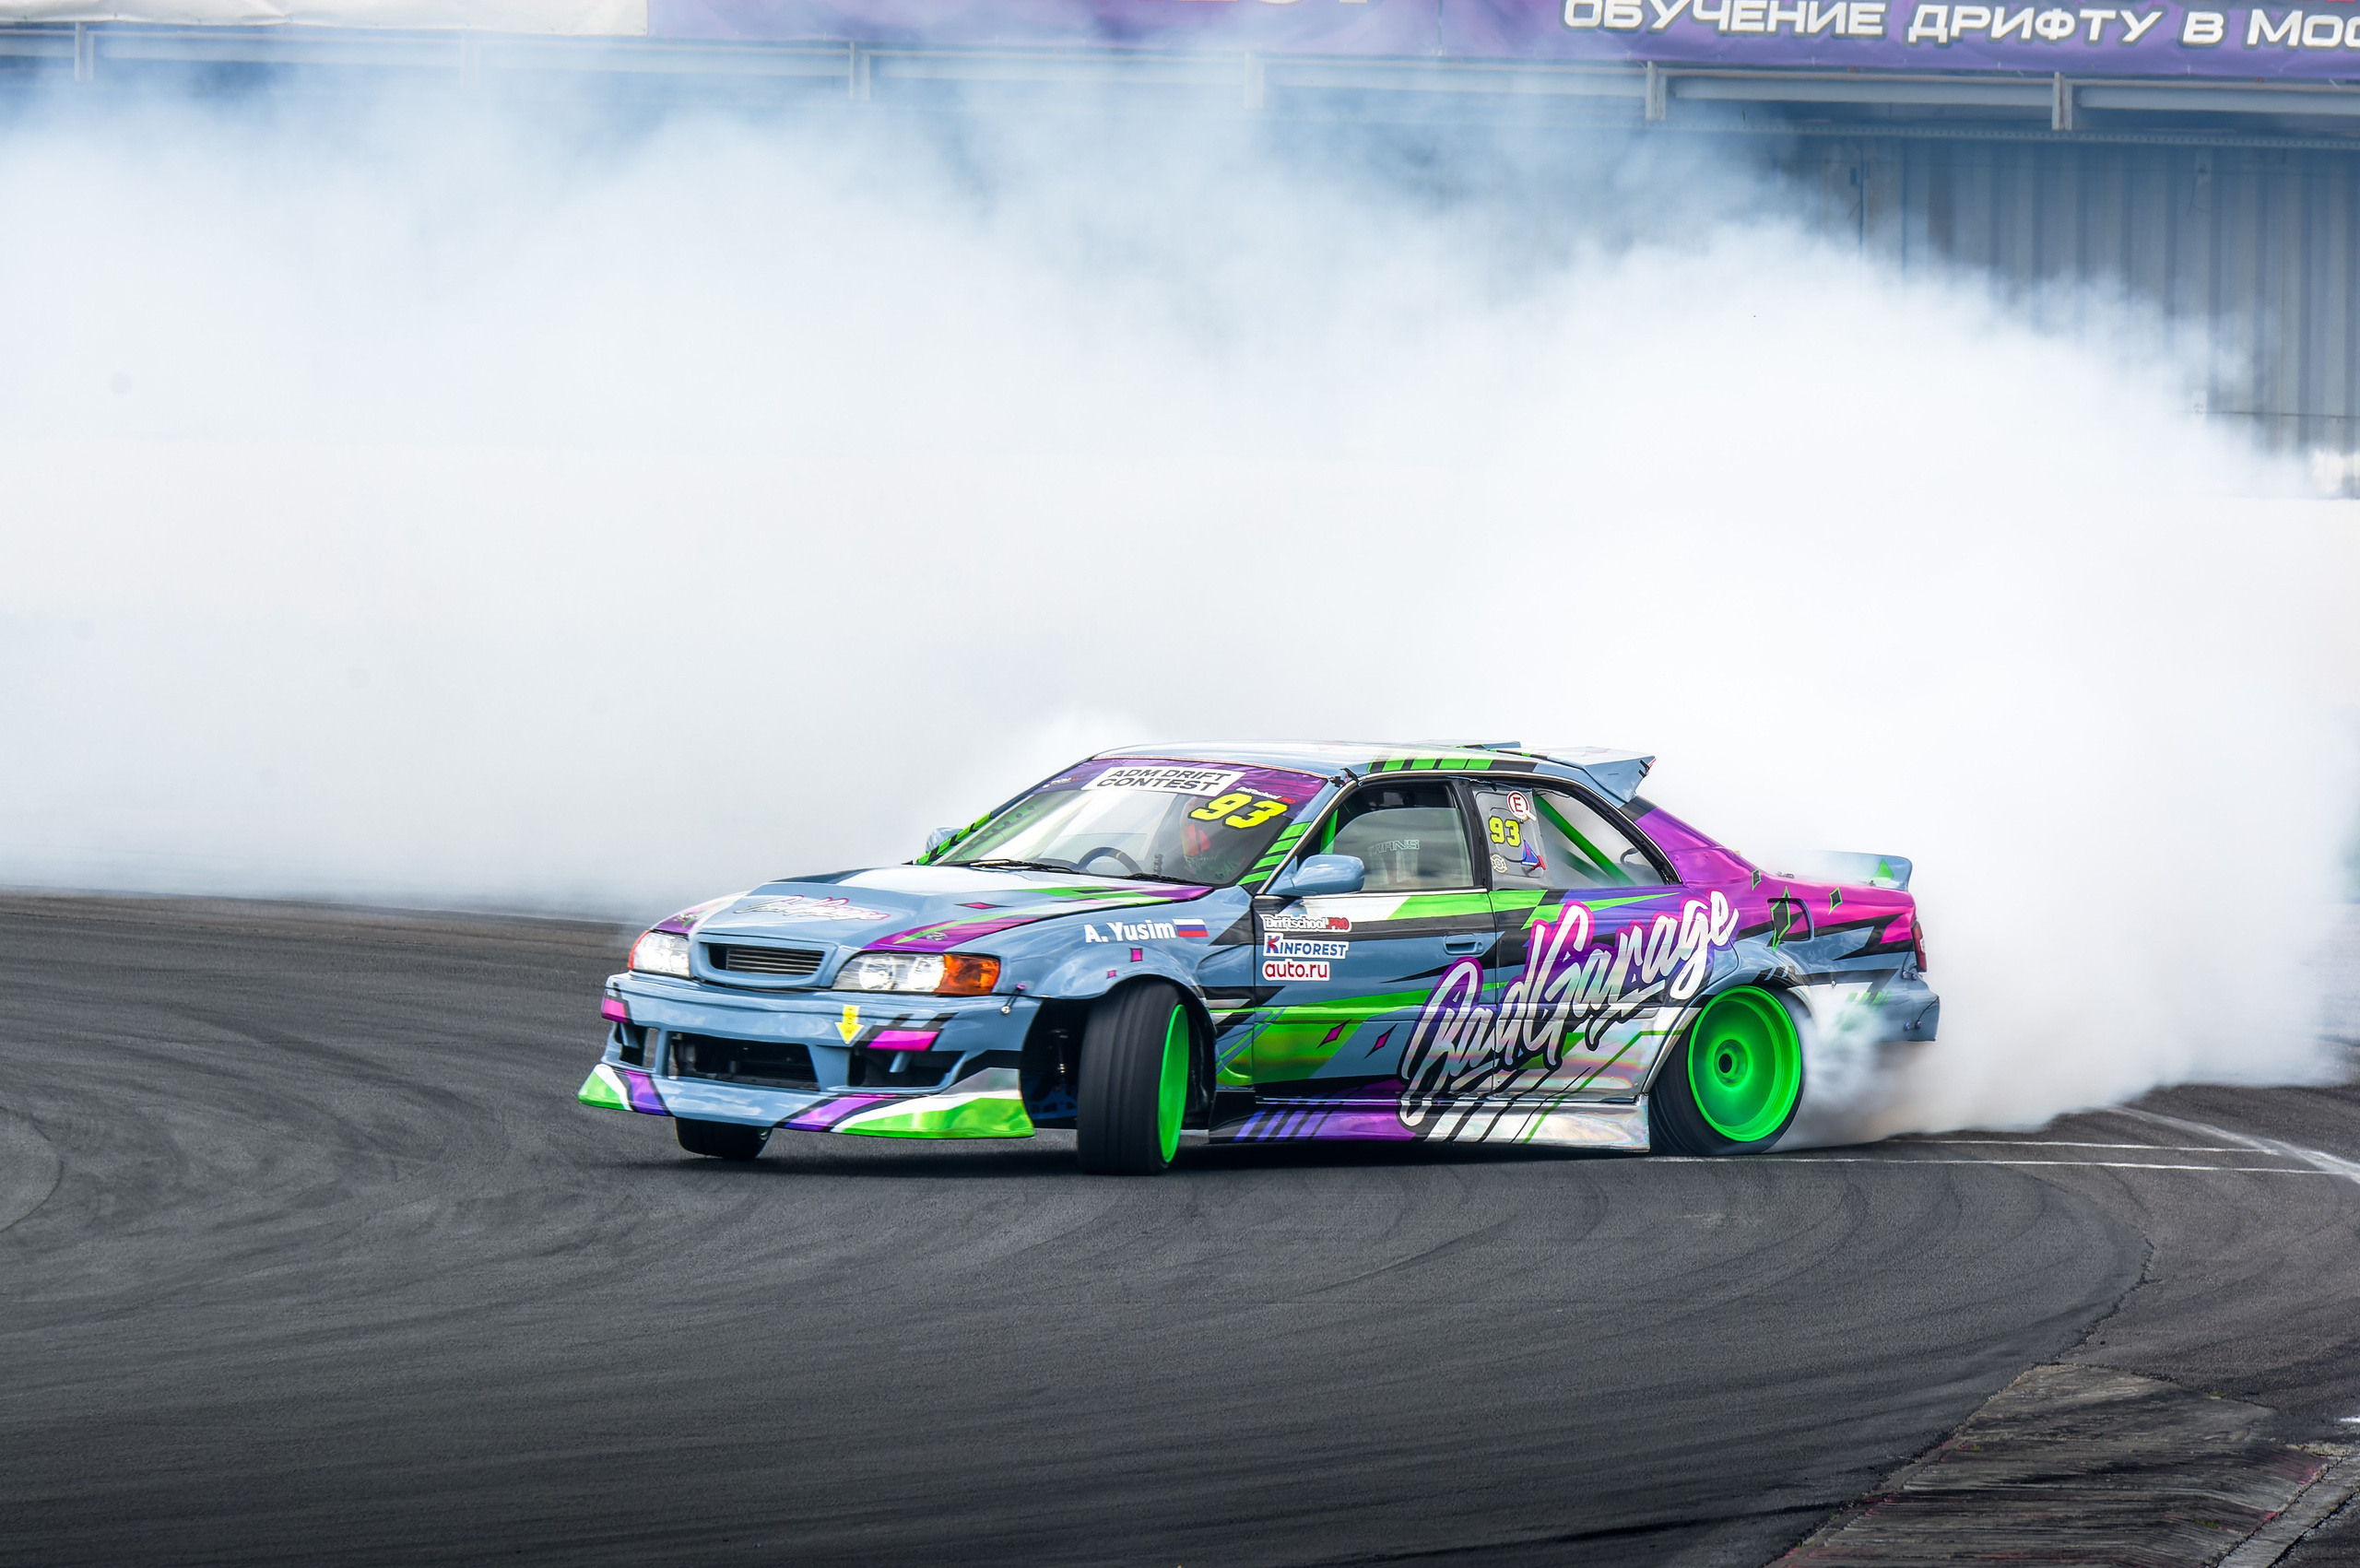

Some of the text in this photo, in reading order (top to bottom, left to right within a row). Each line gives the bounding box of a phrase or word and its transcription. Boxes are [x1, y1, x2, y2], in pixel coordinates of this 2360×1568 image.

[1564, 0, 1886, 35] ОБУЧЕНИЕ
[1907, 4, 2164, 43] ДРИФТУ
[2181, 11, 2224, 44] В
[1096, 777, 1221, 792] CONTEST
[1107, 769, 1232, 783] ADM DRIFT
[1189, 791, 1289, 830] 93
[1488, 816, 1521, 847] 93
[1084, 919, 1177, 943] A. Yusim
[1266, 935, 1347, 957] KINFOREST
[1265, 961, 1328, 978] auto.ru
